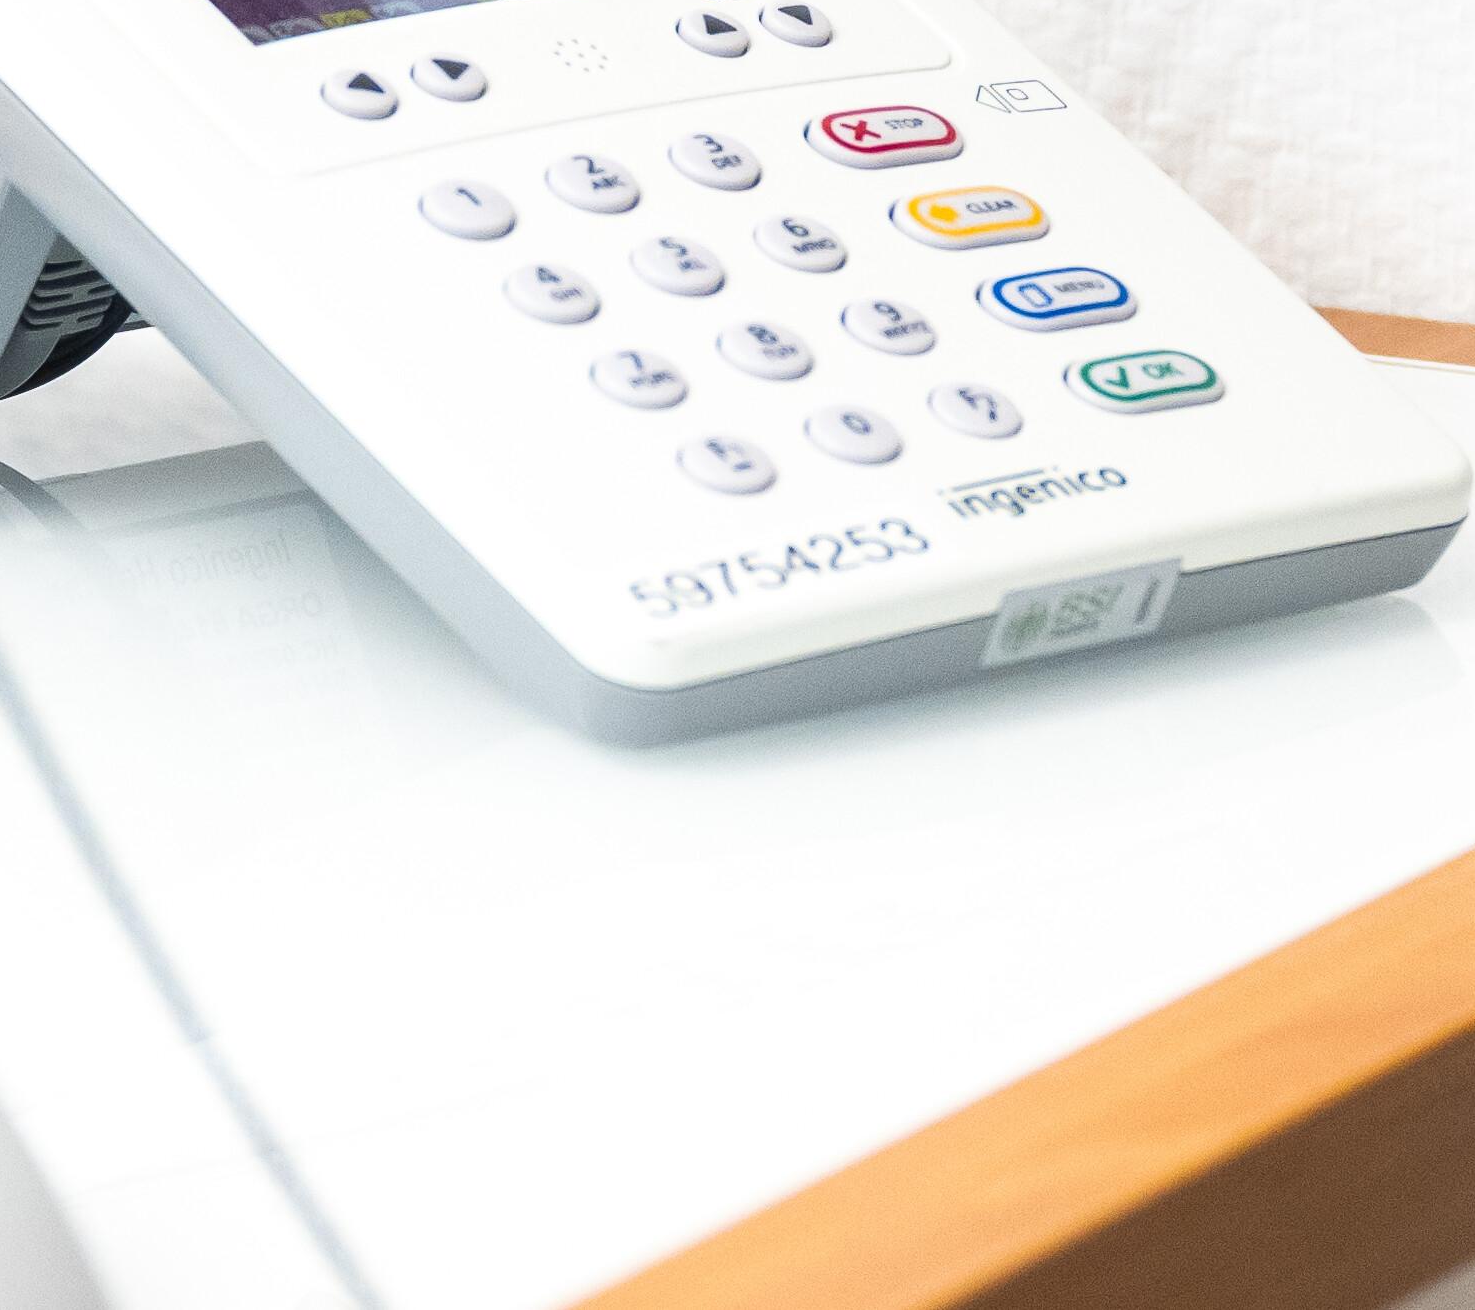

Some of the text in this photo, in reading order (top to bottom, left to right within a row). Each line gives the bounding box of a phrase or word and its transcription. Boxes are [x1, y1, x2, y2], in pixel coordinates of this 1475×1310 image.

[692, 133, 724, 154] 3
[572, 155, 606, 176] 2
[455, 186, 483, 208] 1
[964, 197, 1018, 216] CLEAR
[781, 217, 811, 239] 6
[658, 236, 689, 257] 5
[534, 264, 562, 285] 4
[873, 301, 901, 322] 9
[746, 323, 780, 346] 8
[617, 349, 644, 371] 7
[1140, 362, 1186, 380] OK
[938, 465, 1129, 517] ingenico
[630, 517, 929, 619] 59754253
